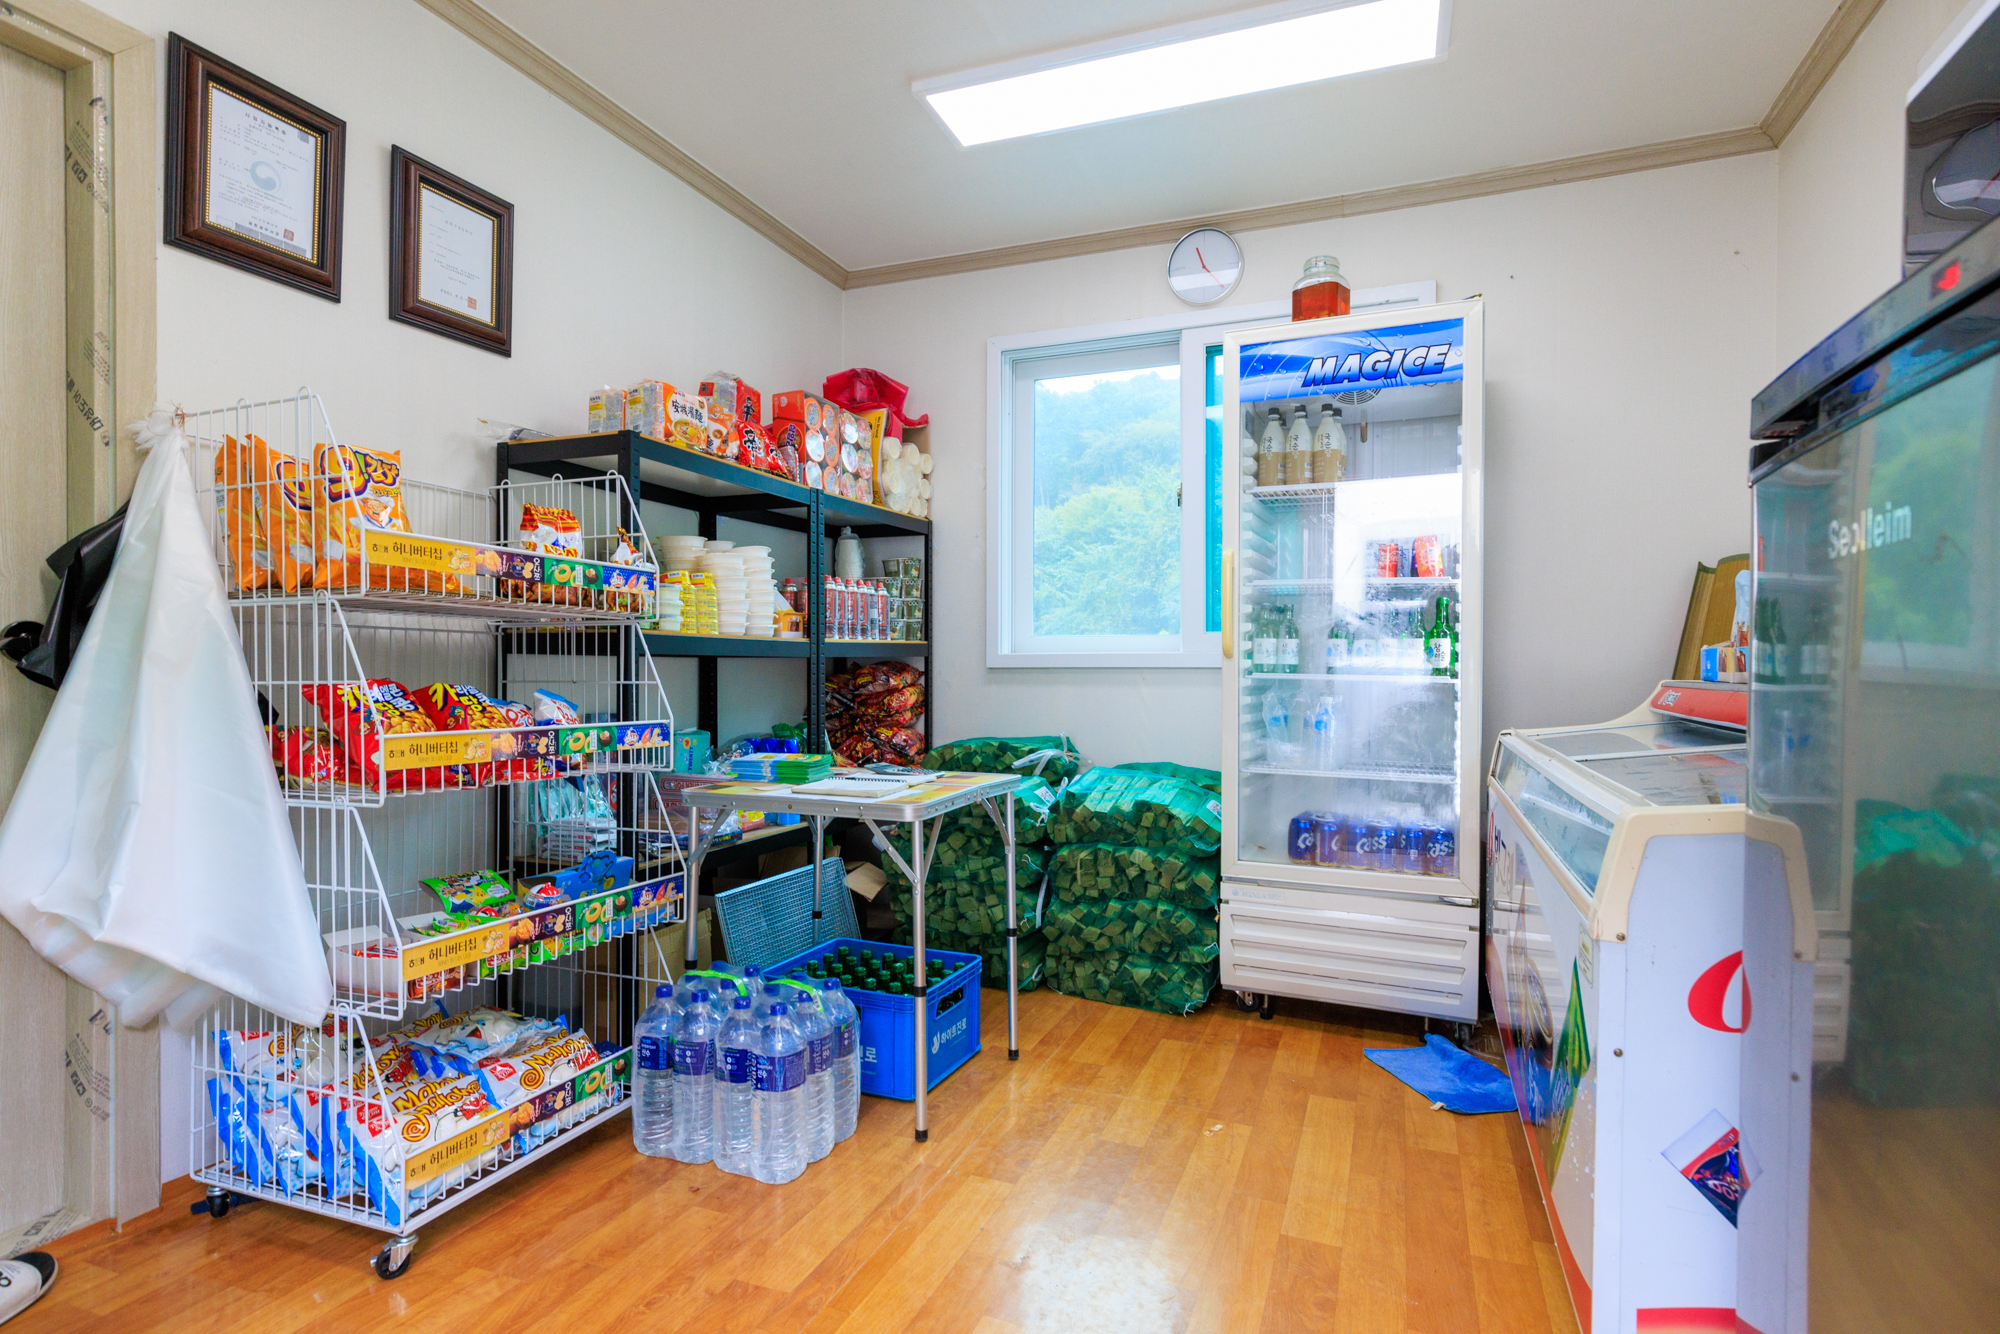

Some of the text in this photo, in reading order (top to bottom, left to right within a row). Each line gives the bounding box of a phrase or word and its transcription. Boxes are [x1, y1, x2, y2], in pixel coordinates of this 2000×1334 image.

[1301, 343, 1452, 388] MAGICE
[392, 541, 442, 560] 허니버터칩
[409, 741, 458, 756] 허니버터칩
[429, 937, 477, 960] 허니버터칩
[430, 1132, 478, 1164] 허니버터칩
